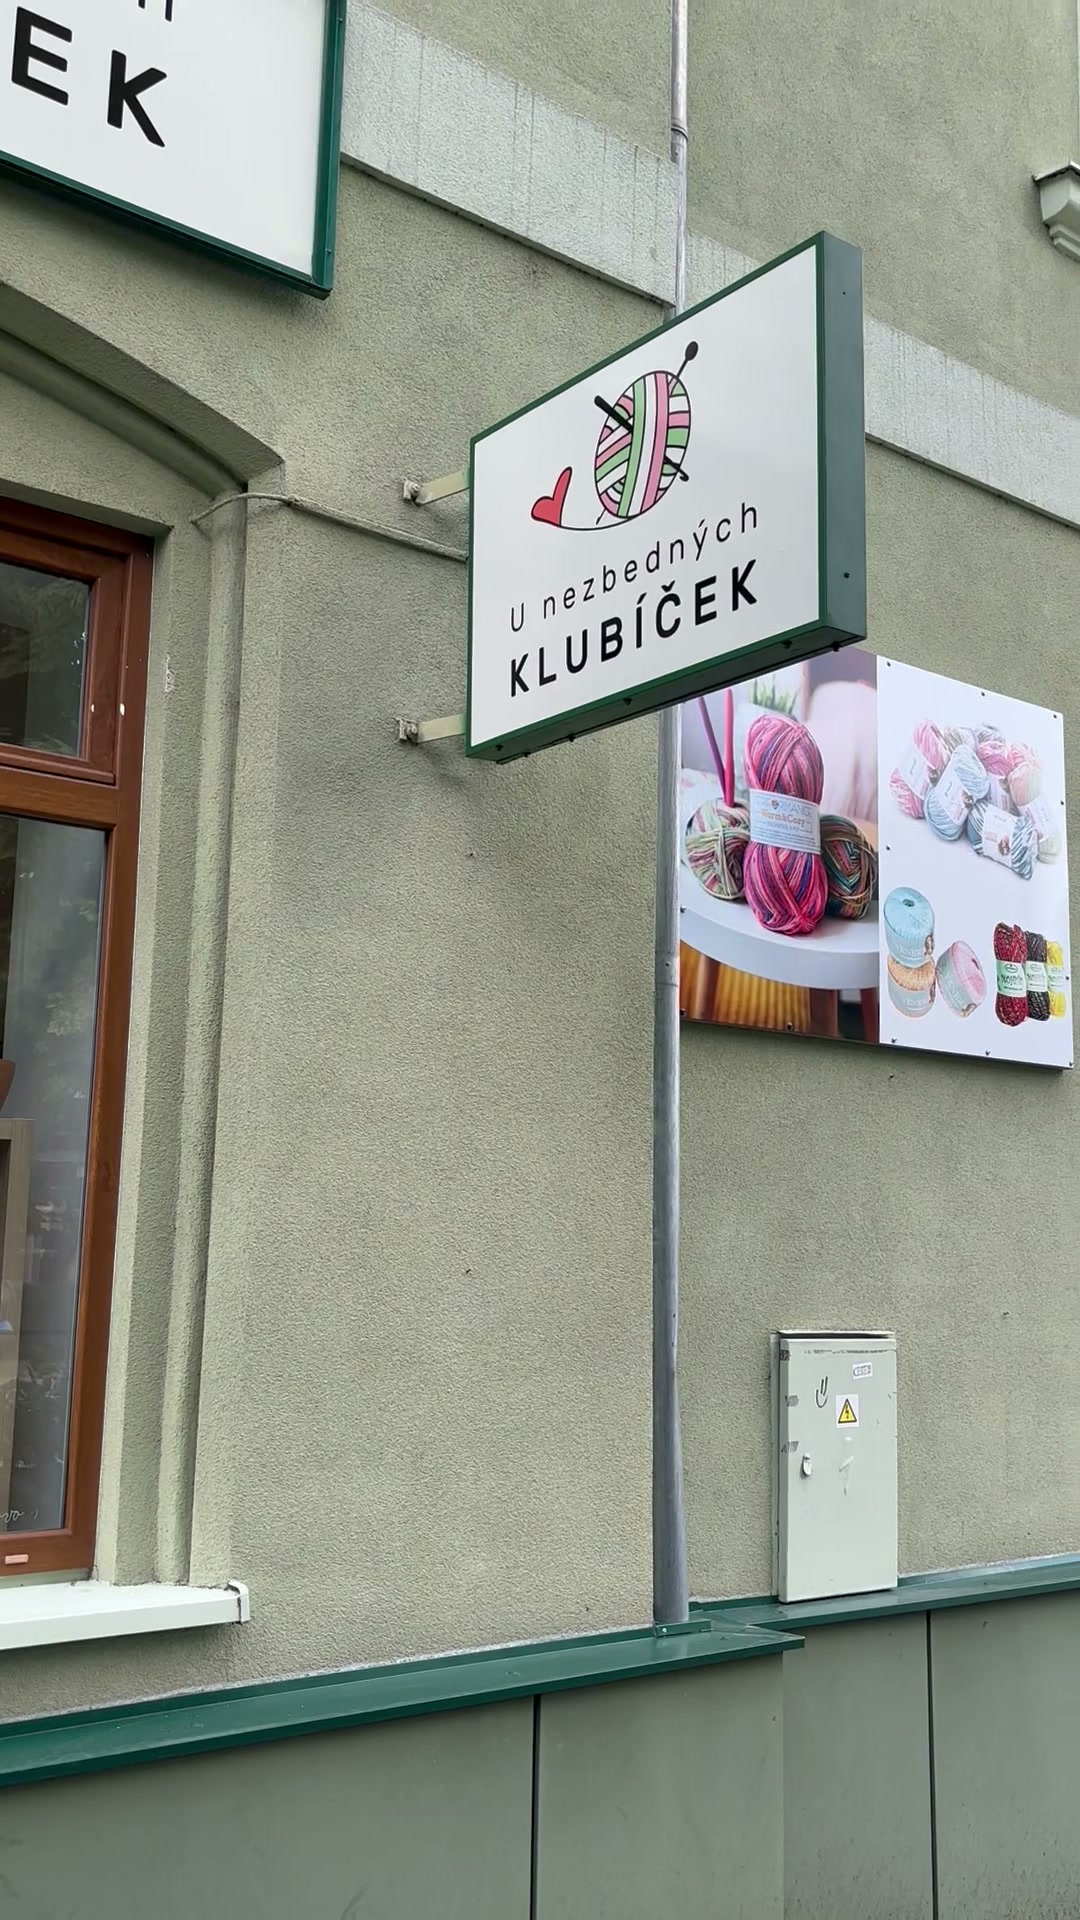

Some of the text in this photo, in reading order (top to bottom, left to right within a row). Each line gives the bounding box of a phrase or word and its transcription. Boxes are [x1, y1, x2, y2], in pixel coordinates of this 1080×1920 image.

[509, 558, 759, 697] KLUBÍČEK
[510, 503, 759, 632] U nezbedných
